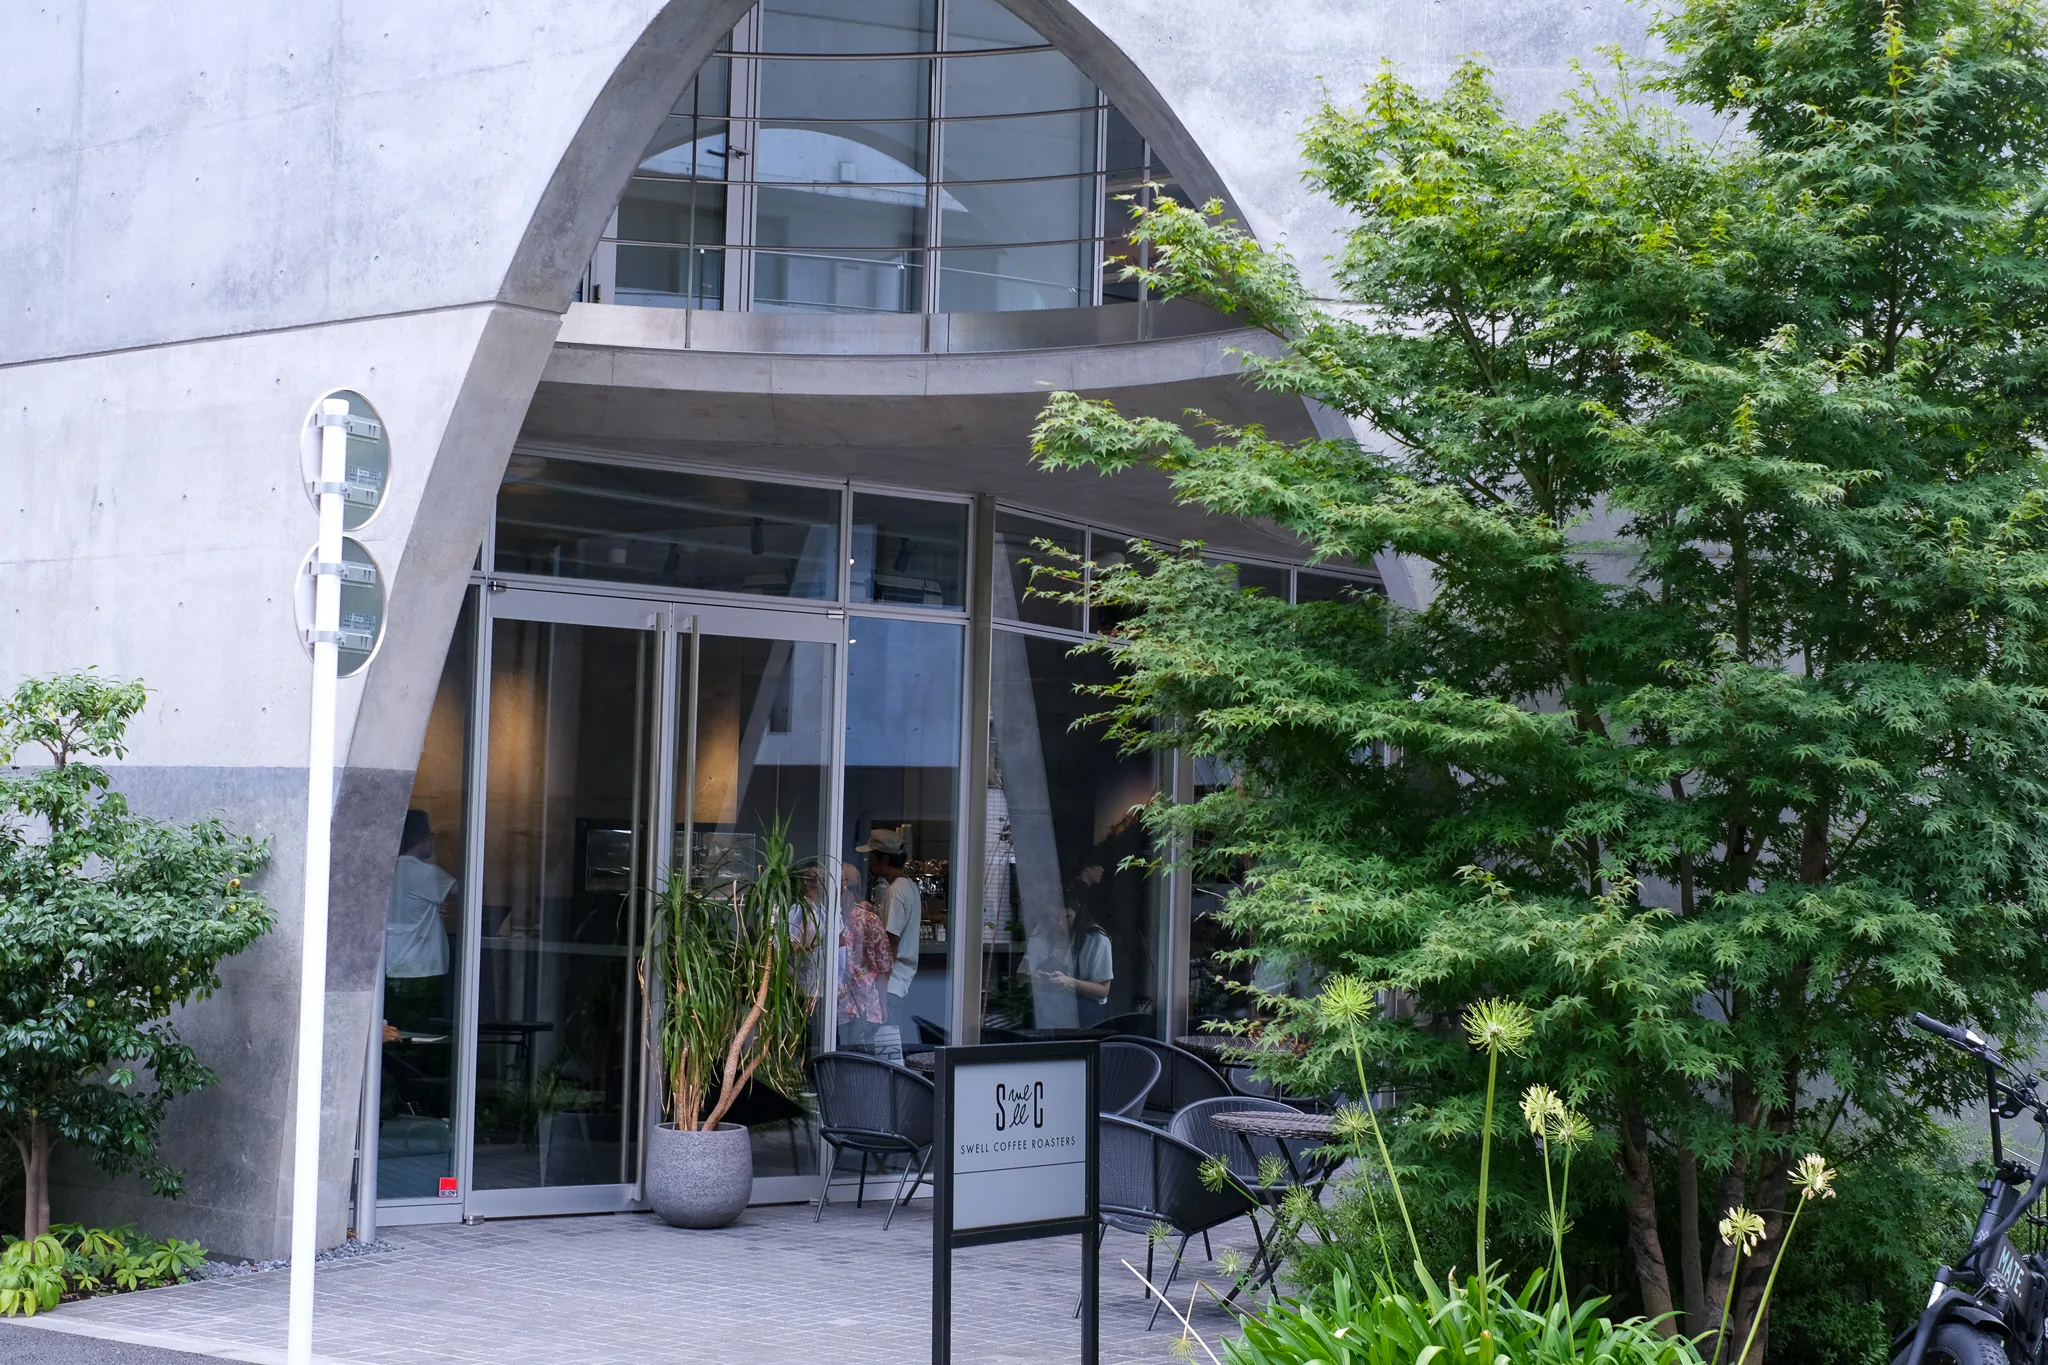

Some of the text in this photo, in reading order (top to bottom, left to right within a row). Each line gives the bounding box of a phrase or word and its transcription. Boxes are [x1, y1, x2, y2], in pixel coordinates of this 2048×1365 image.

[960, 1136, 1076, 1155] SWELL COFFEE ROASTERS
[1998, 1245, 2025, 1298] MATE.
